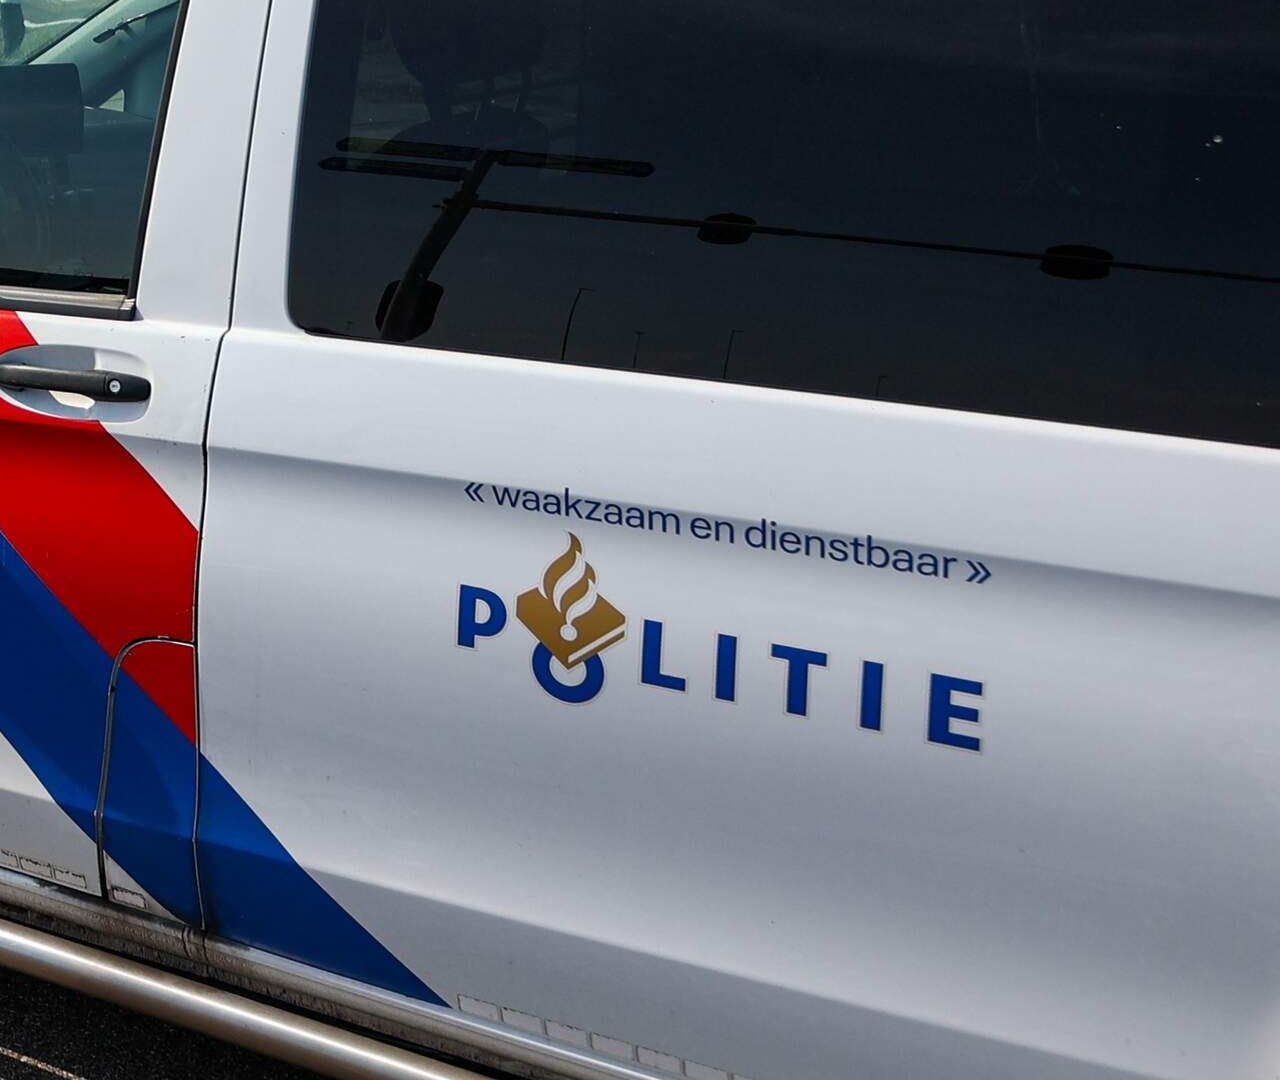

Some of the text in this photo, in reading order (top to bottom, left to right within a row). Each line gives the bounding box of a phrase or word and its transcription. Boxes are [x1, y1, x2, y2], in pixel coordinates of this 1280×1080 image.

[491, 484, 681, 536] waakzaam
[689, 517, 735, 544] en
[744, 518, 958, 579] dienstbaar
[456, 584, 984, 752] POLITIE
